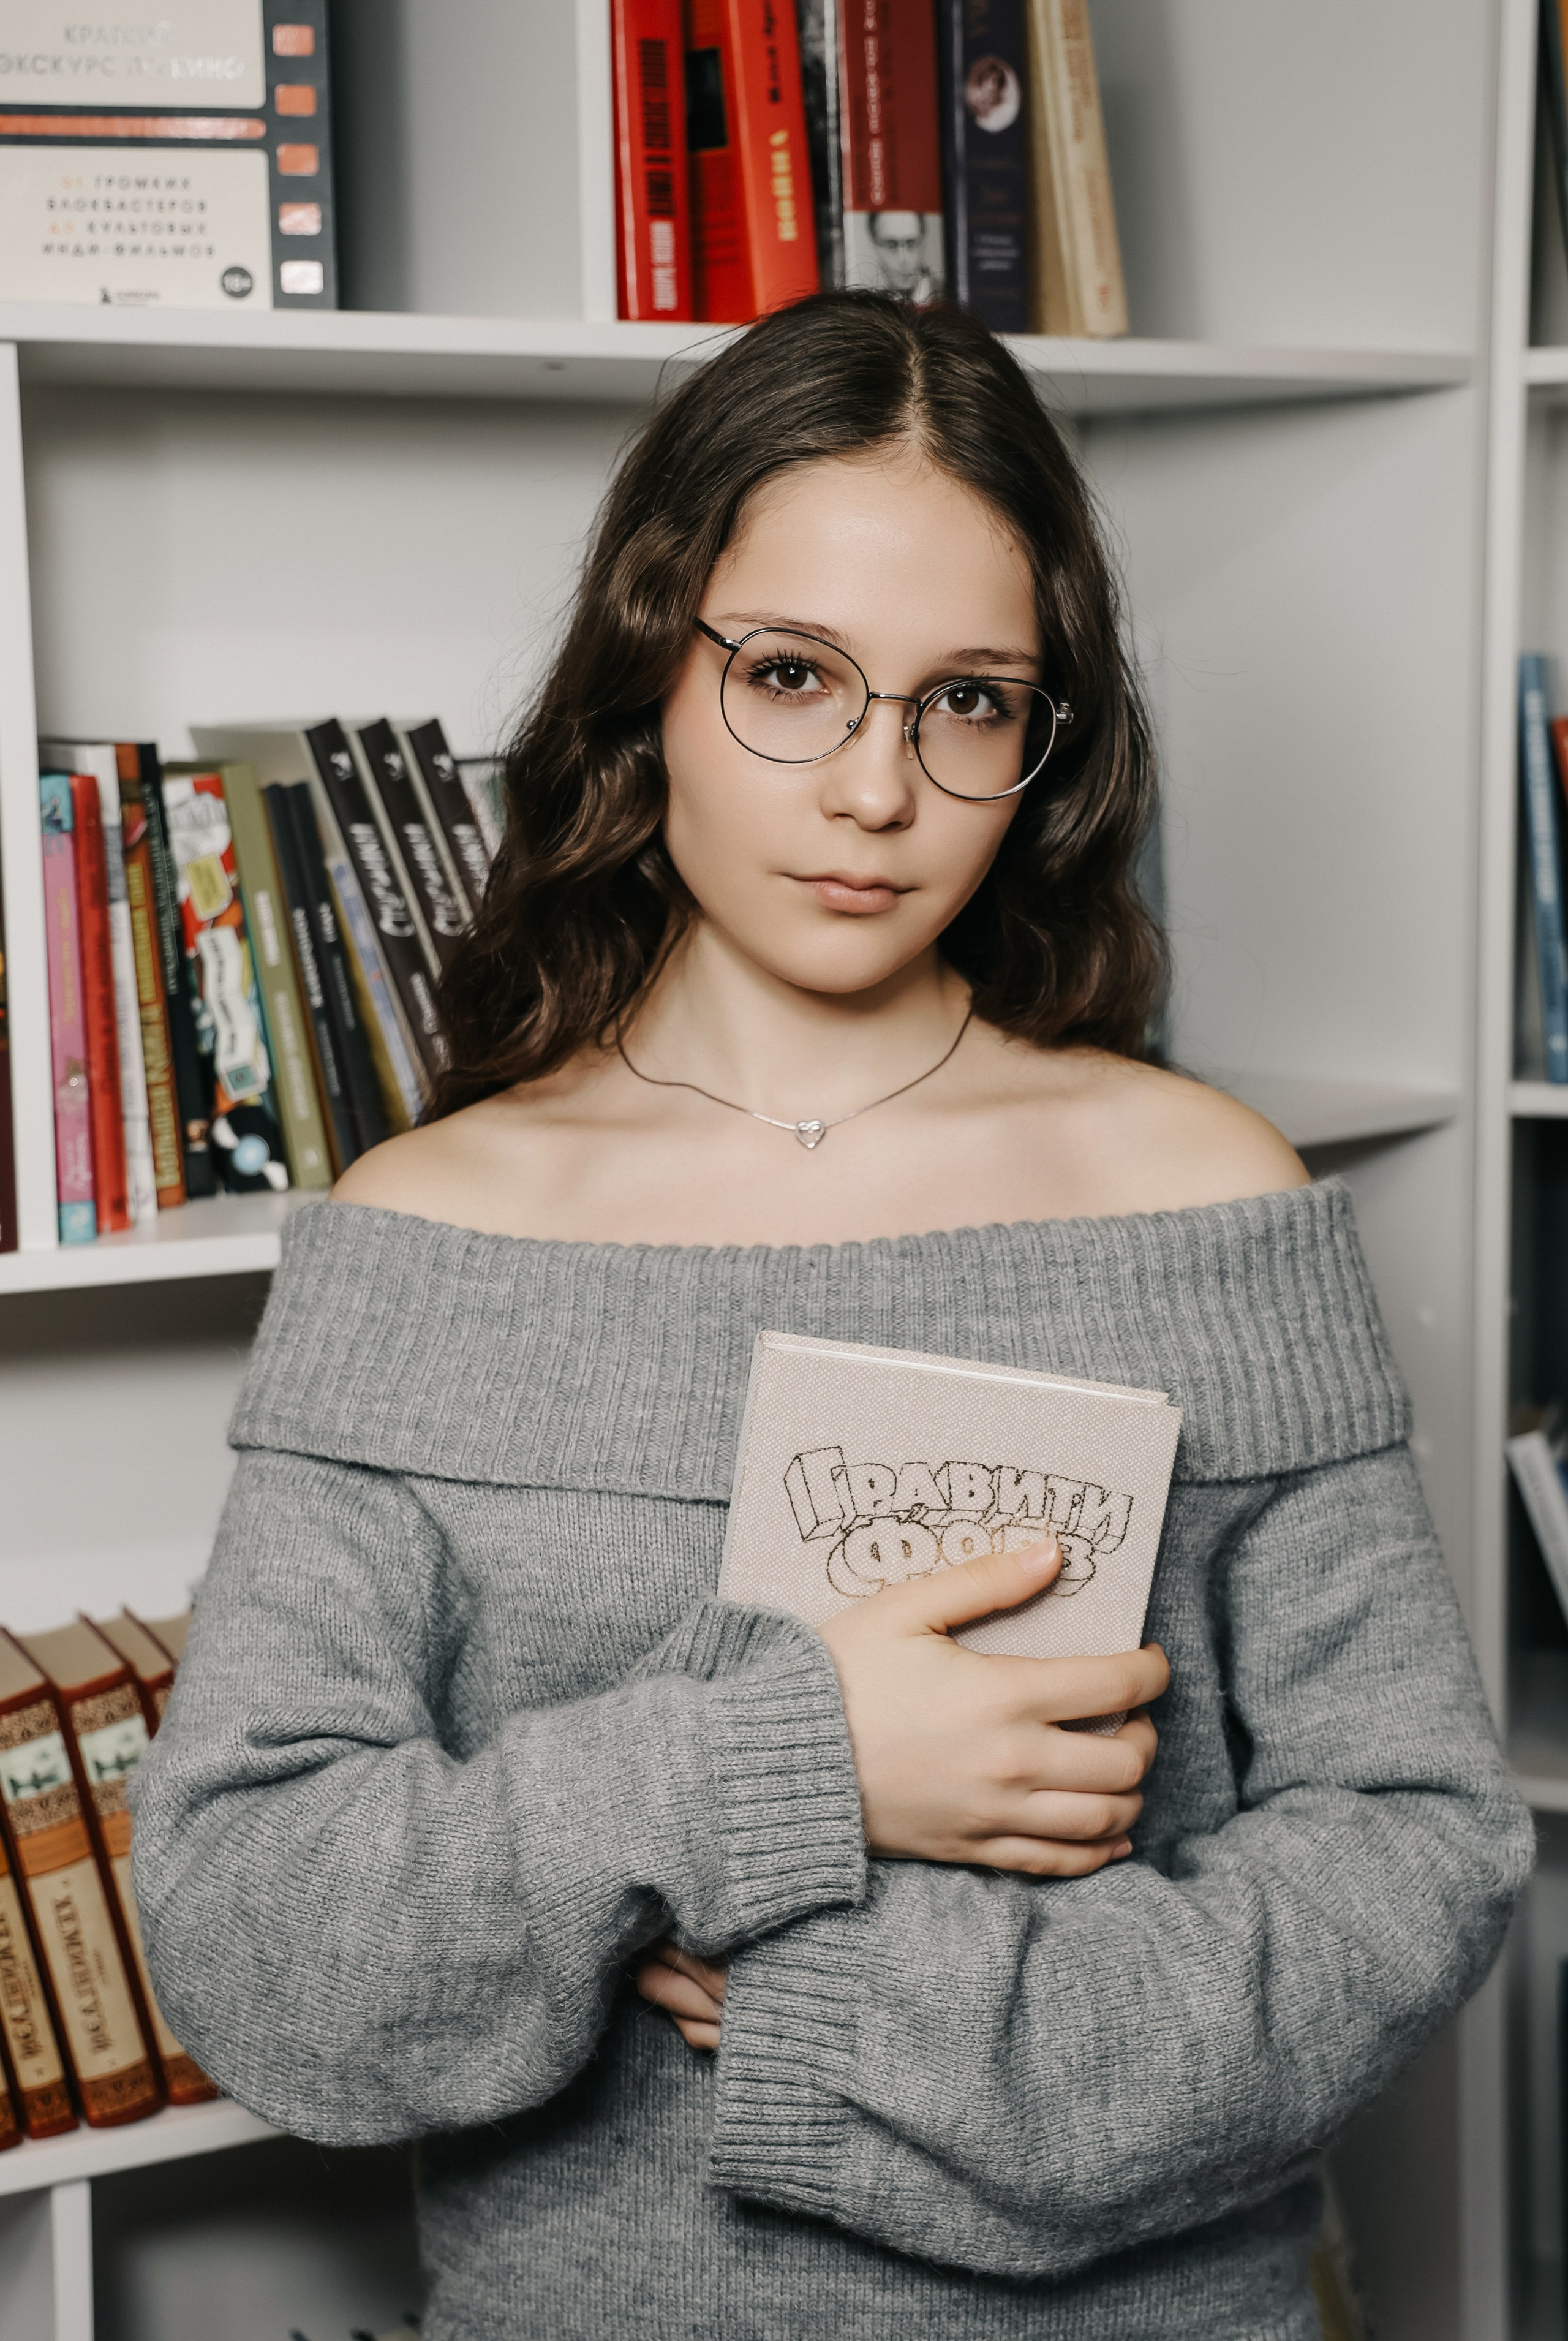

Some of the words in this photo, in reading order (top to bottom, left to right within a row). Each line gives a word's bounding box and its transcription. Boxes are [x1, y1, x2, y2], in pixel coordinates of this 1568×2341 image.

[0, 53, 118, 77] ЭКСКУРС
[170, 55, 246, 80] КИНО
[47, 196, 209, 214] БЛОКБАСТЕРОВ
[783, 1445, 1134, 1554] ГРАВИТИ
